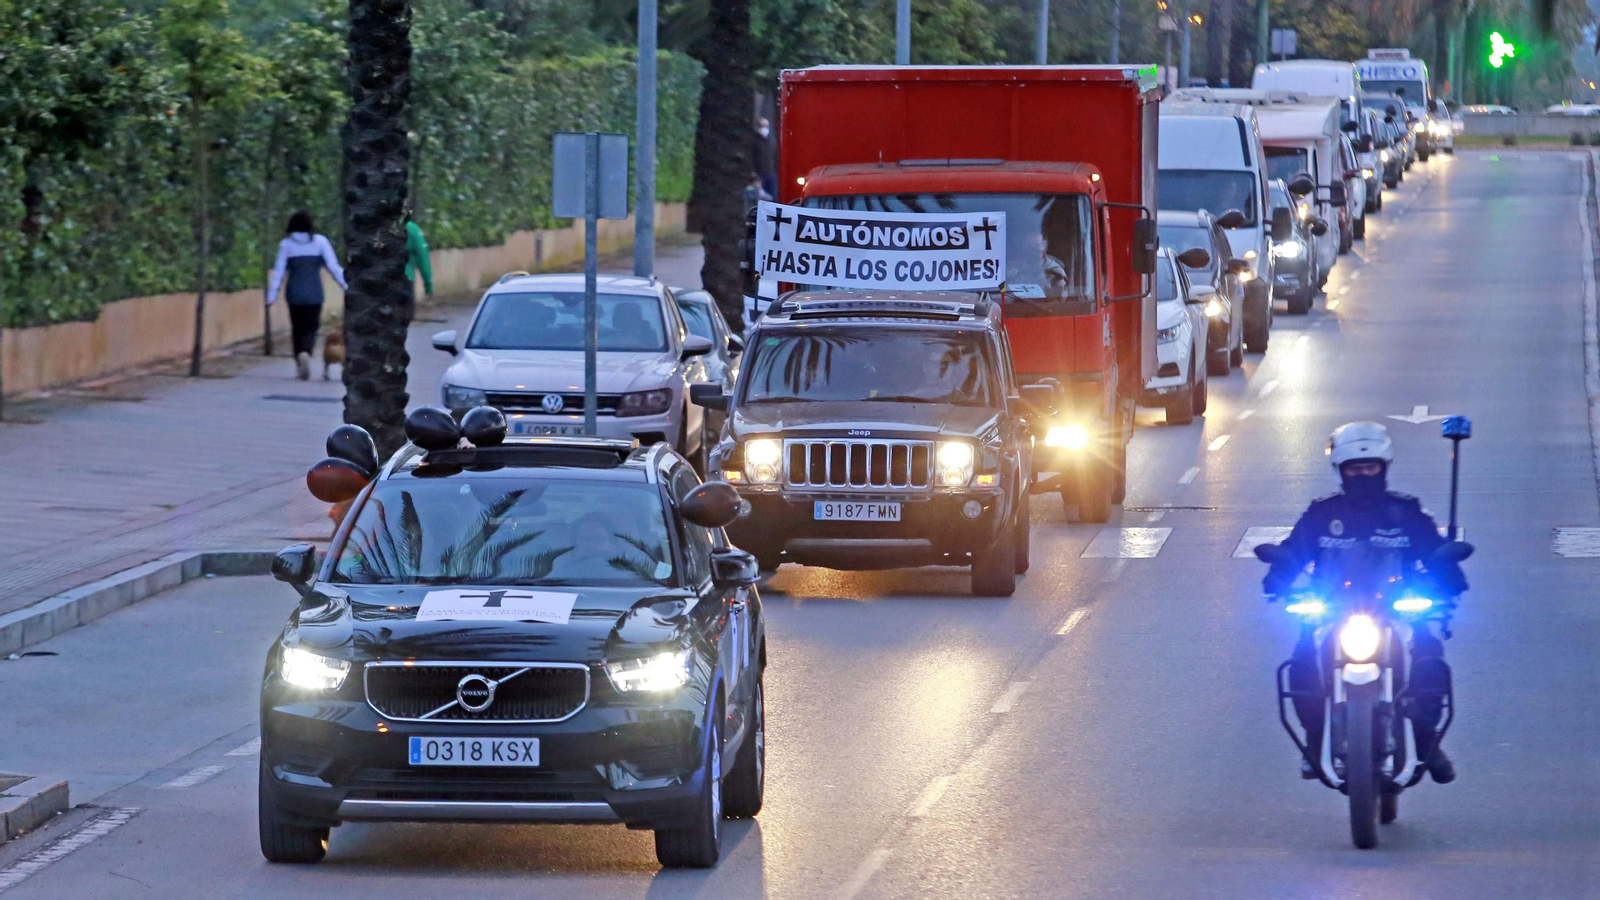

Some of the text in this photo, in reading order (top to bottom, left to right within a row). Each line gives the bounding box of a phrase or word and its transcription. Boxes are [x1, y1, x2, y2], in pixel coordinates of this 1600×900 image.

[799, 221, 965, 247] AUTÓNOMOS
[761, 249, 1000, 282] ¡HASTA LOS COJONES!
[848, 429, 871, 437] Jeep
[825, 504, 864, 518] 9187
[868, 504, 897, 519] FMN
[426, 740, 534, 762] 0318 KSX
